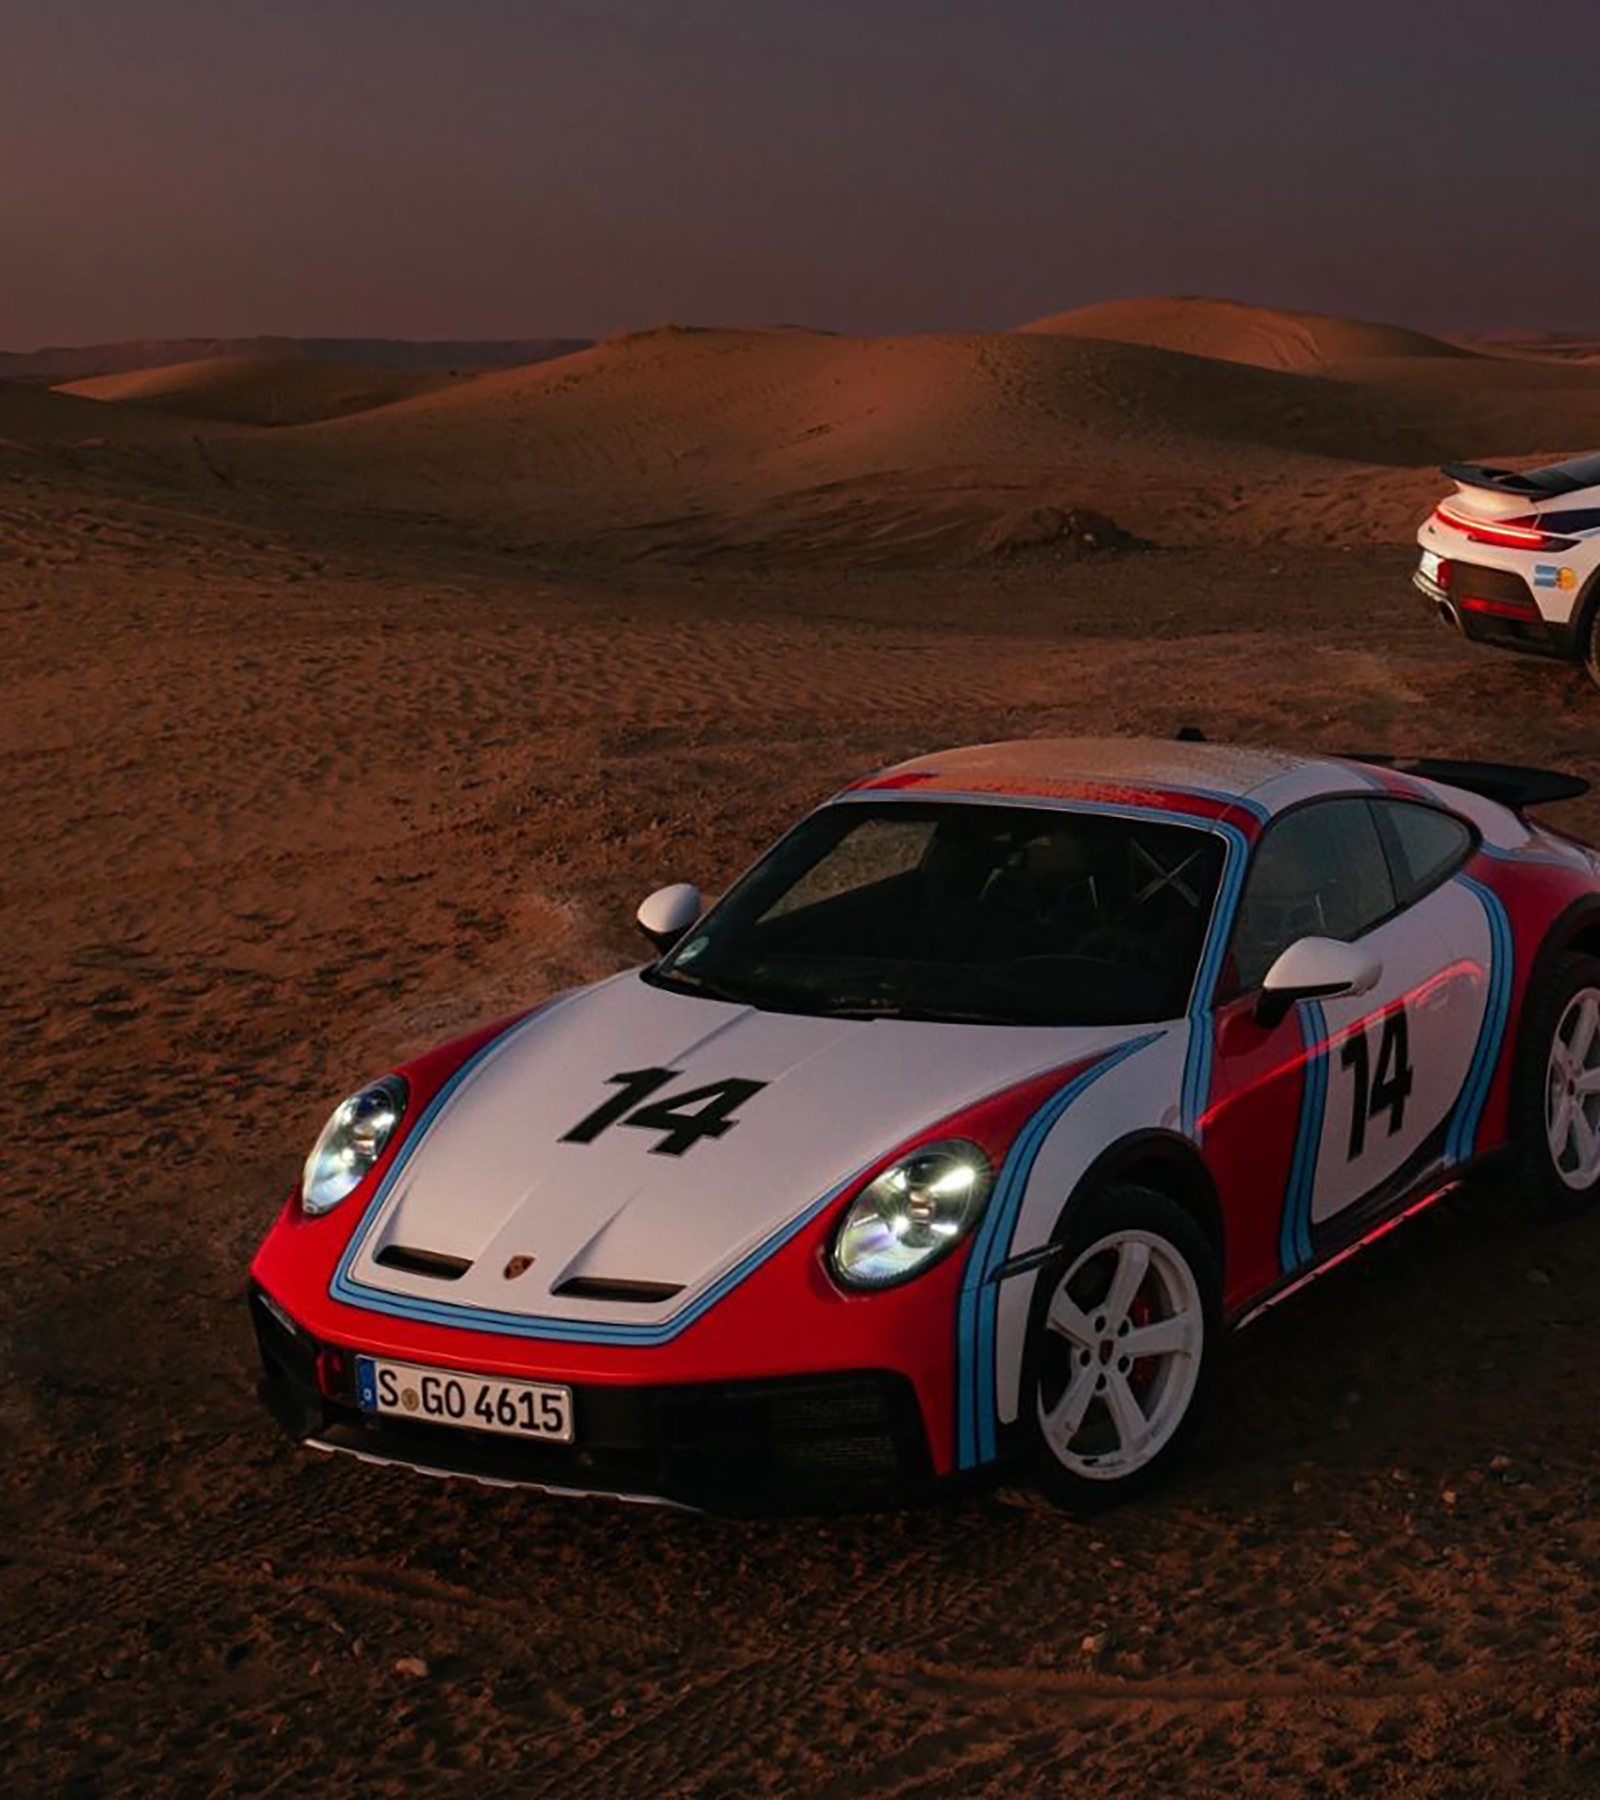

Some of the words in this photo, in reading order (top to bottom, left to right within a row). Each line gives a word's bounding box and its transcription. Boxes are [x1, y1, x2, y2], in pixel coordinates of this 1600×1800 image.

[556, 1066, 772, 1157] 14
[1341, 1002, 1413, 1162] 14
[378, 1369, 399, 1407] S
[420, 1376, 466, 1419] GO
[474, 1385, 564, 1432] 4615
